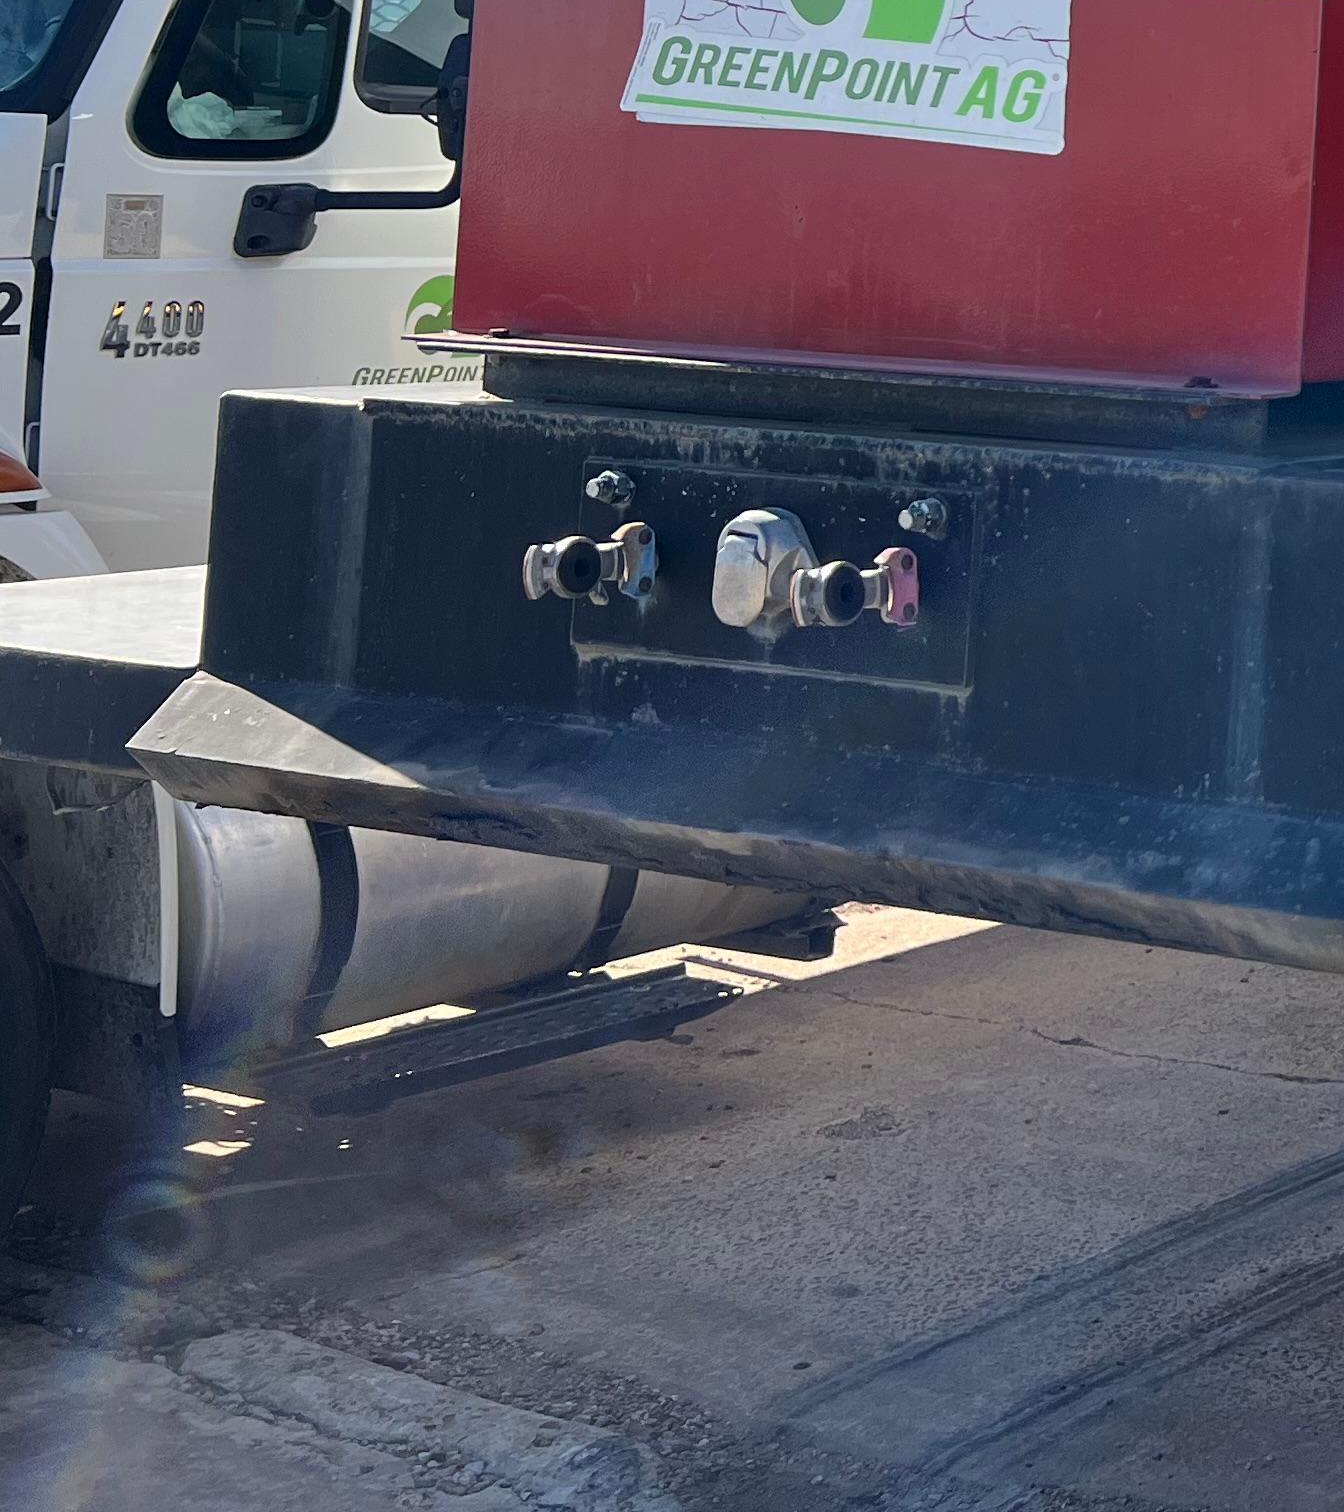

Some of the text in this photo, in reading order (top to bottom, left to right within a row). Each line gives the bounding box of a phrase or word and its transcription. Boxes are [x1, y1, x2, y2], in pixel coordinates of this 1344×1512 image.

[652, 35, 961, 108] GREENPOINT
[133, 340, 201, 359] DT466
[352, 364, 486, 386] GREENPOIN
